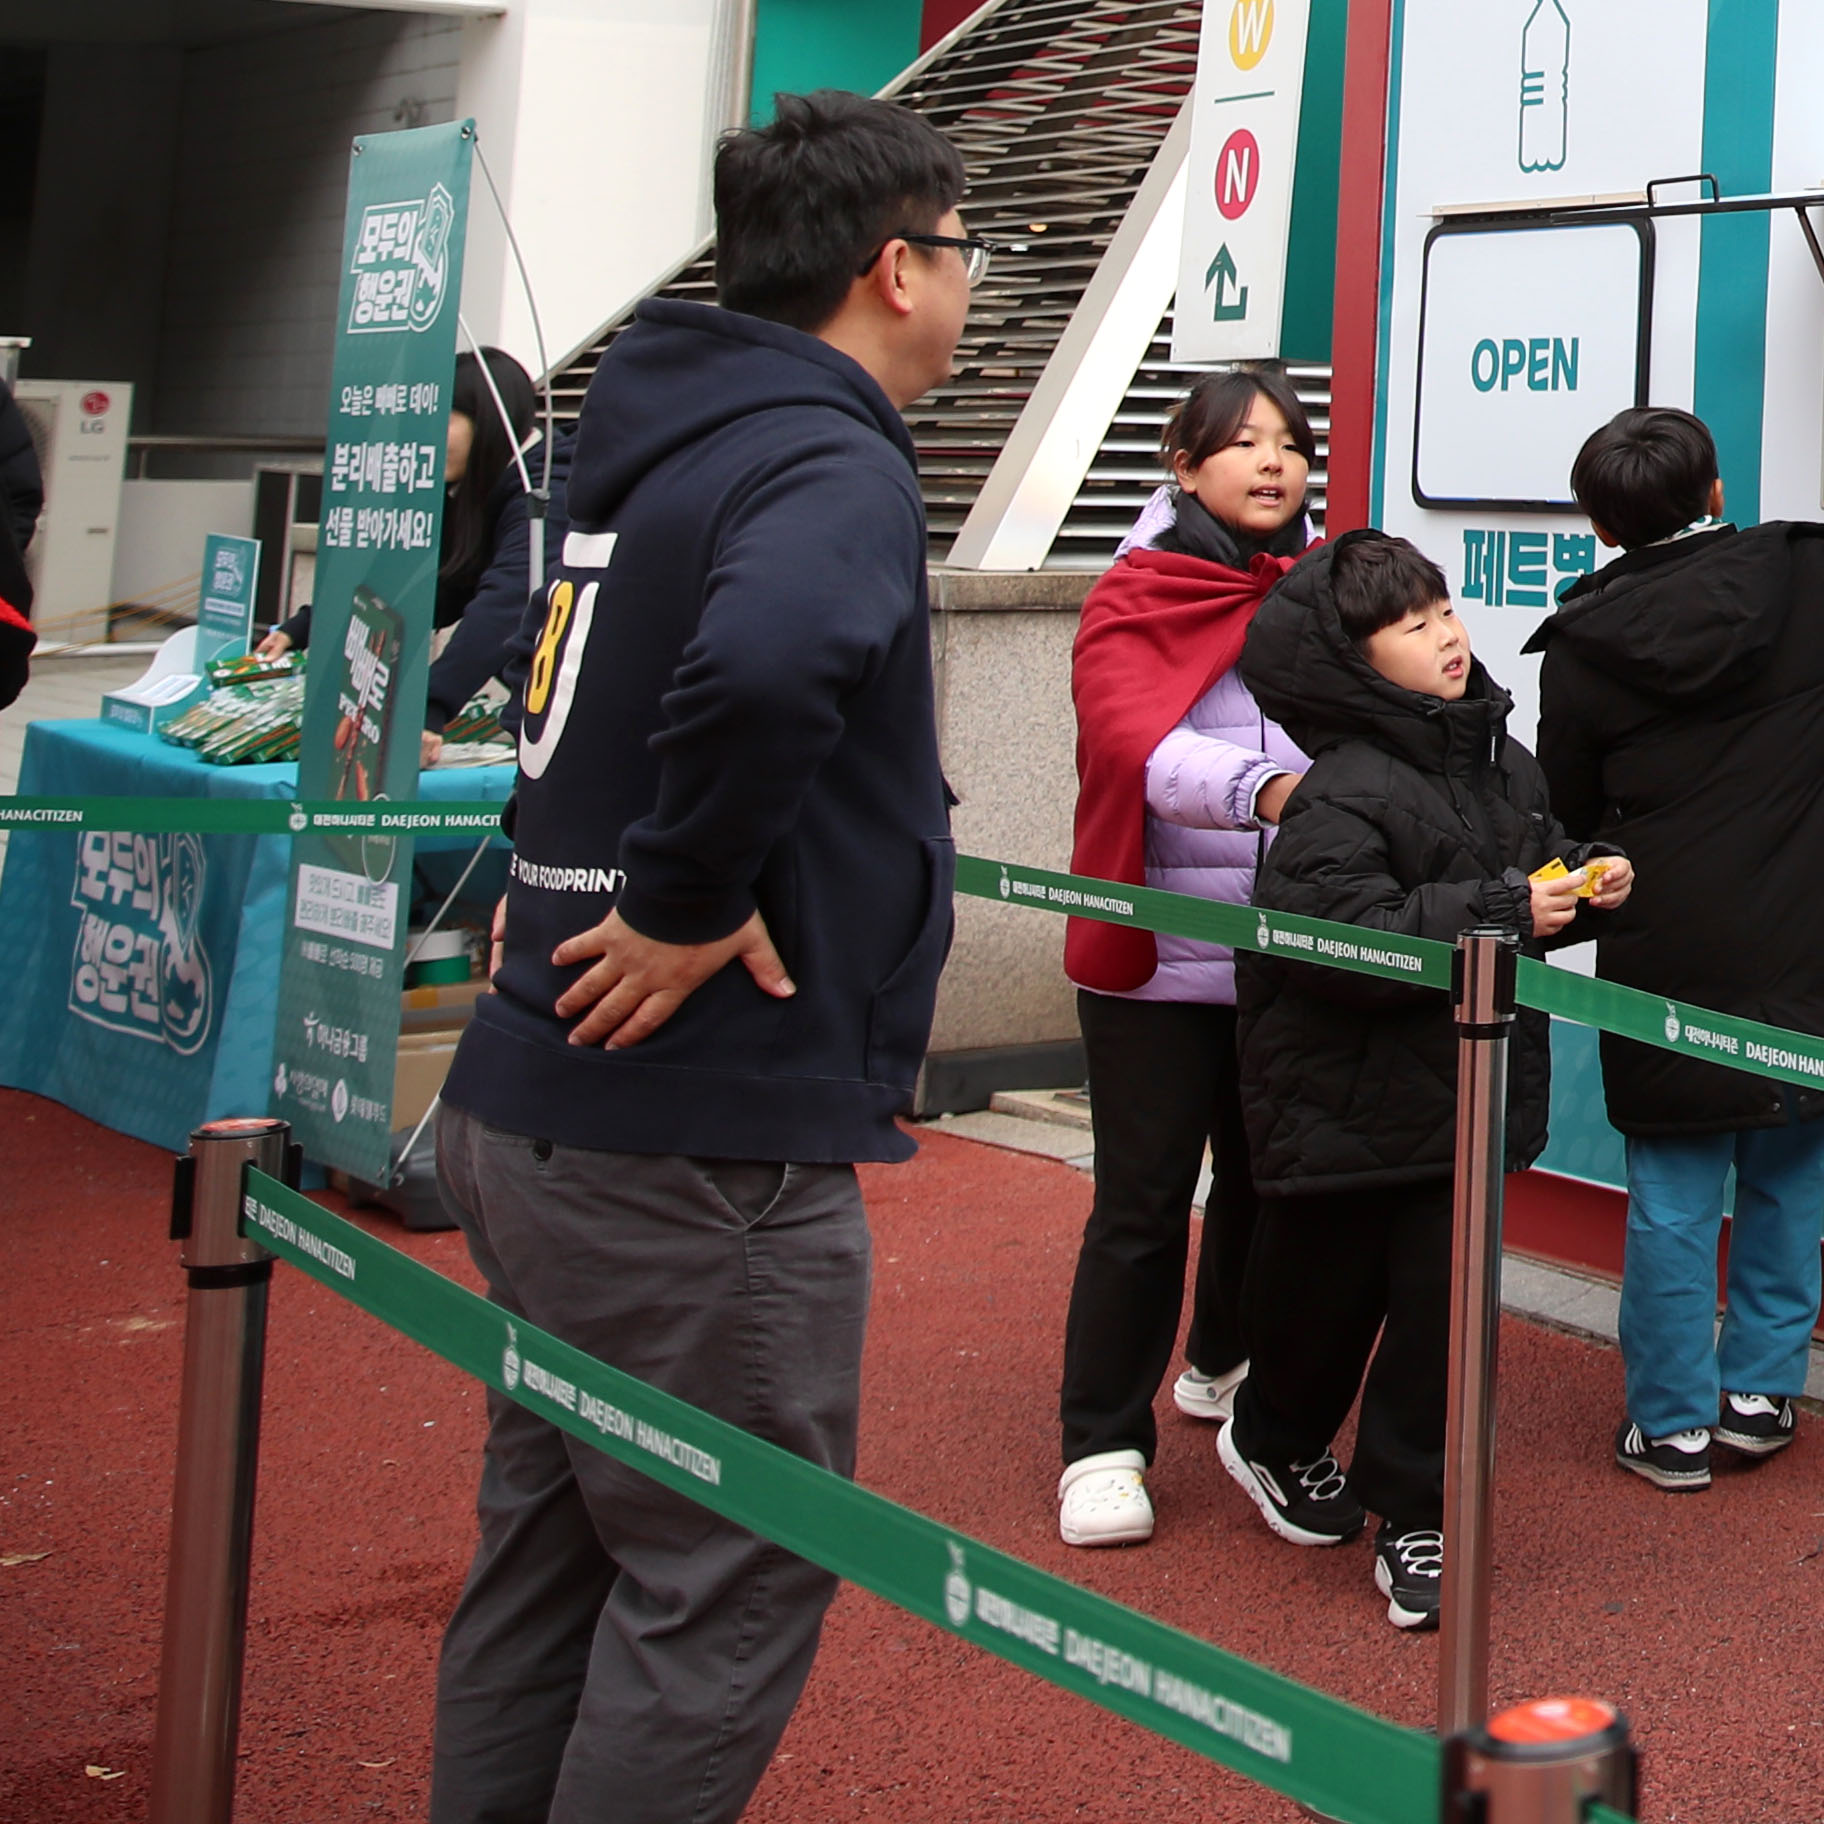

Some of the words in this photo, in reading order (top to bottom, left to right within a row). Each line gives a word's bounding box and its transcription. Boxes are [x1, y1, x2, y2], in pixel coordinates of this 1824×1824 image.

[1237, 2, 1268, 58] W
[1224, 149, 1249, 202] N
[357, 211, 418, 264] 모두의
[354, 269, 416, 324] 행운권
[1471, 336, 1580, 393] OPEN
[339, 384, 374, 416] 오늘은
[375, 383, 408, 415] 빼빼로
[409, 382, 439, 416] 데이!
[80, 421, 104, 434] LG
[331, 441, 437, 494] 분리배출하고
[325, 507, 354, 548] 선물
[356, 507, 434, 551] 받아가세요!
[381, 813, 441, 829] DAEJEON
[80, 831, 160, 921] 모두의
[519, 858, 540, 887] YOUR
[1048, 886, 1082, 906] DAEJEON
[1083, 893, 1134, 917] HANACITIZEN
[75, 912, 160, 1024] 행운권
[1317, 938, 1358, 959] DAEJEON
[1359, 947, 1423, 973] HANACITIZEN
[1745, 1041, 1797, 1068] DAEJEON
